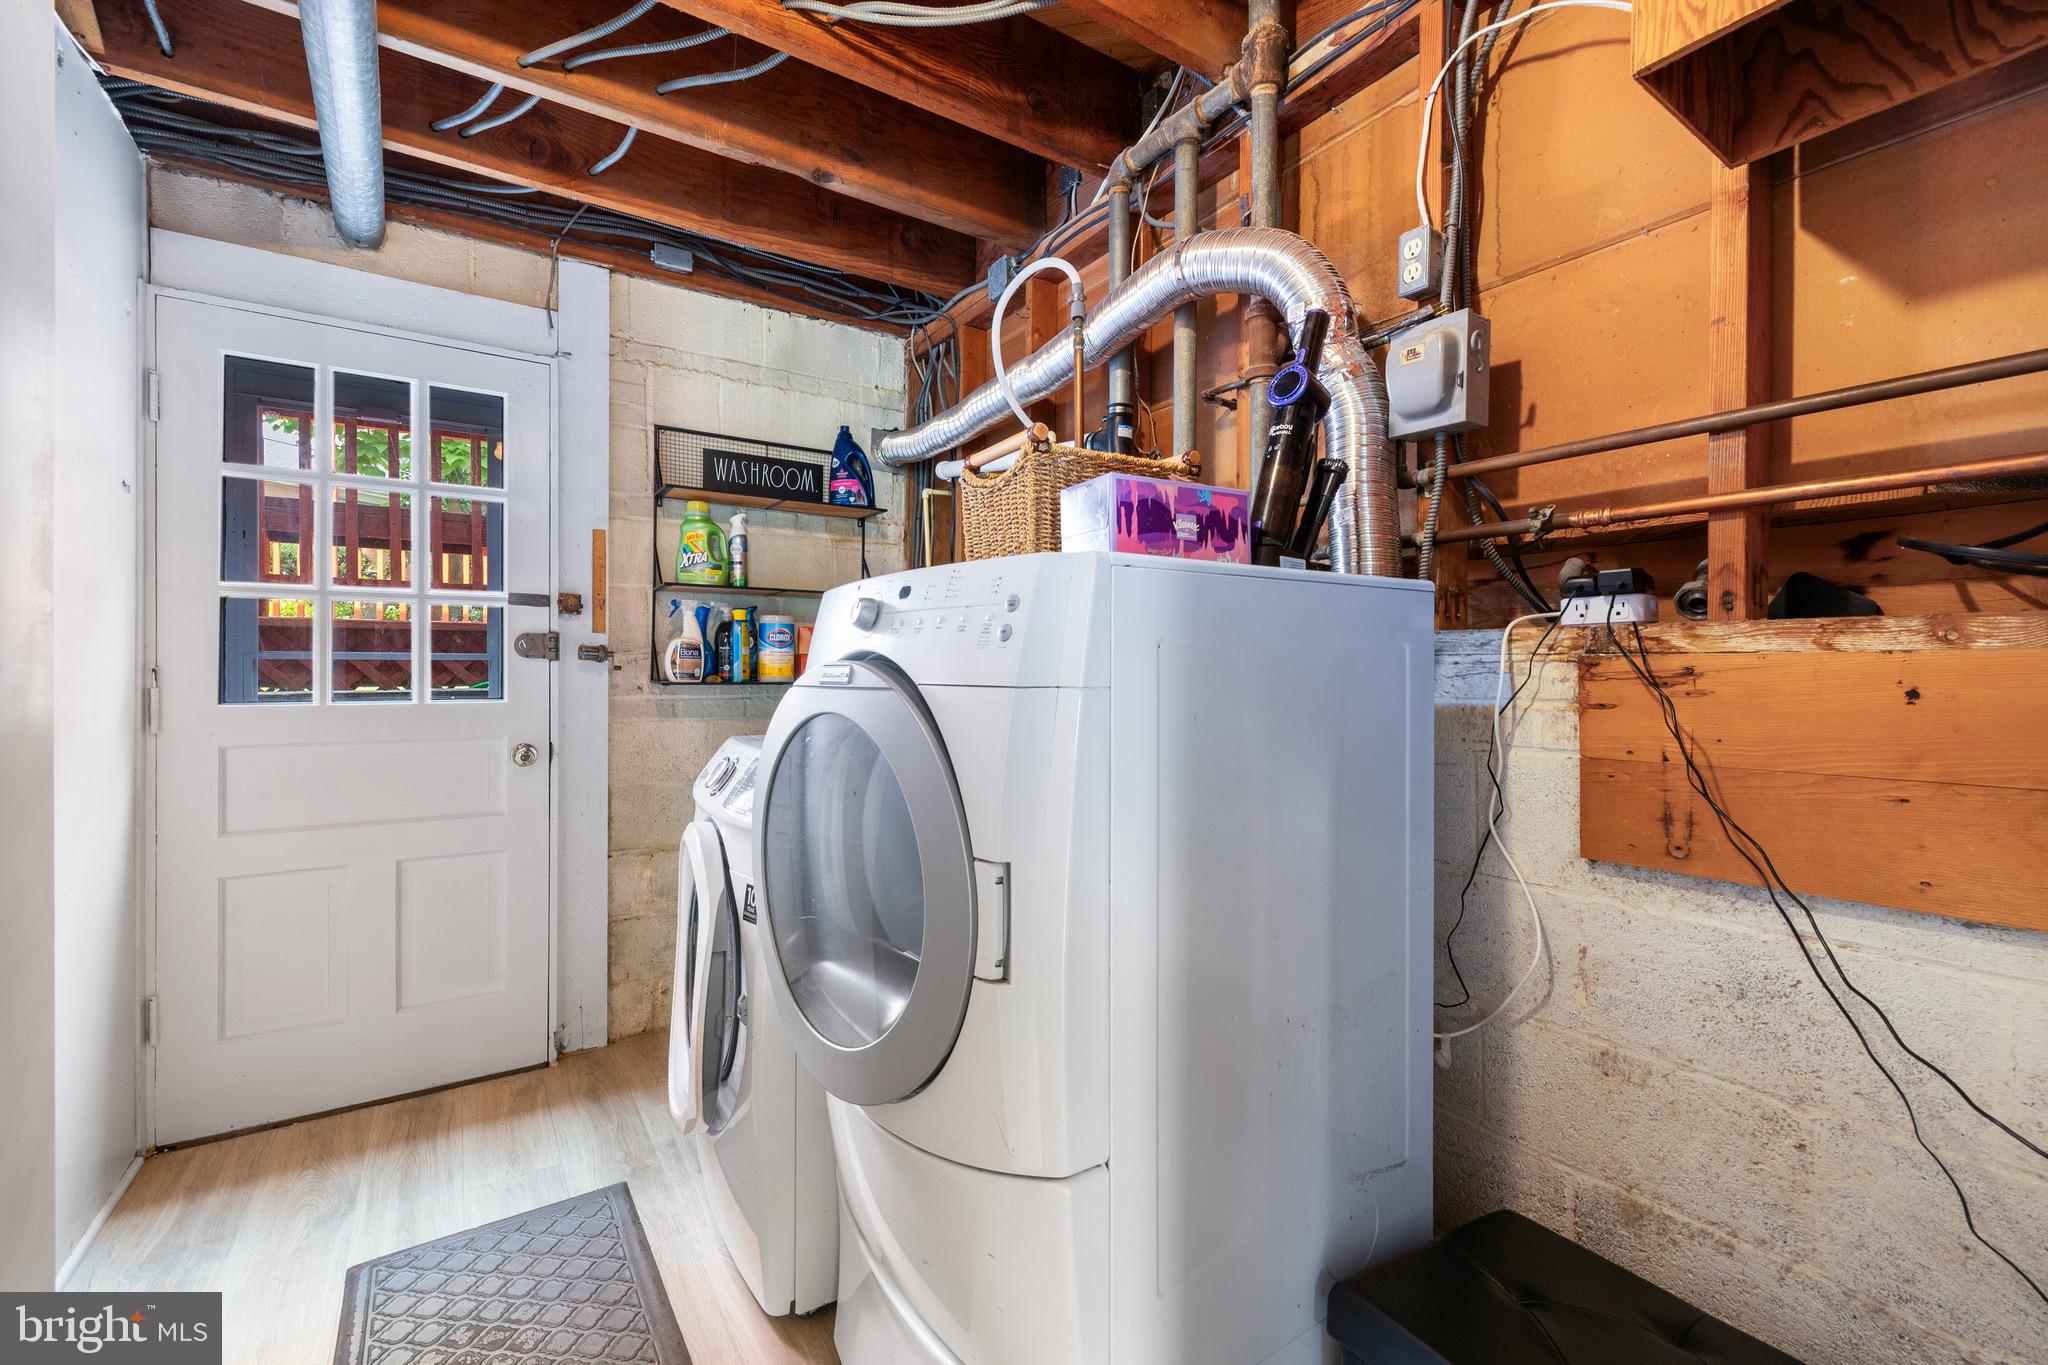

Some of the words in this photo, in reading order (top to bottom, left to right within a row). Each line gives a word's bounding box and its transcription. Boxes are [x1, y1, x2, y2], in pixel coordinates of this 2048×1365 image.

[713, 456, 819, 493] WASHROOM.
[680, 551, 708, 567] XTRA
[769, 633, 791, 641] CLOROX
[680, 648, 699, 656] Bona
